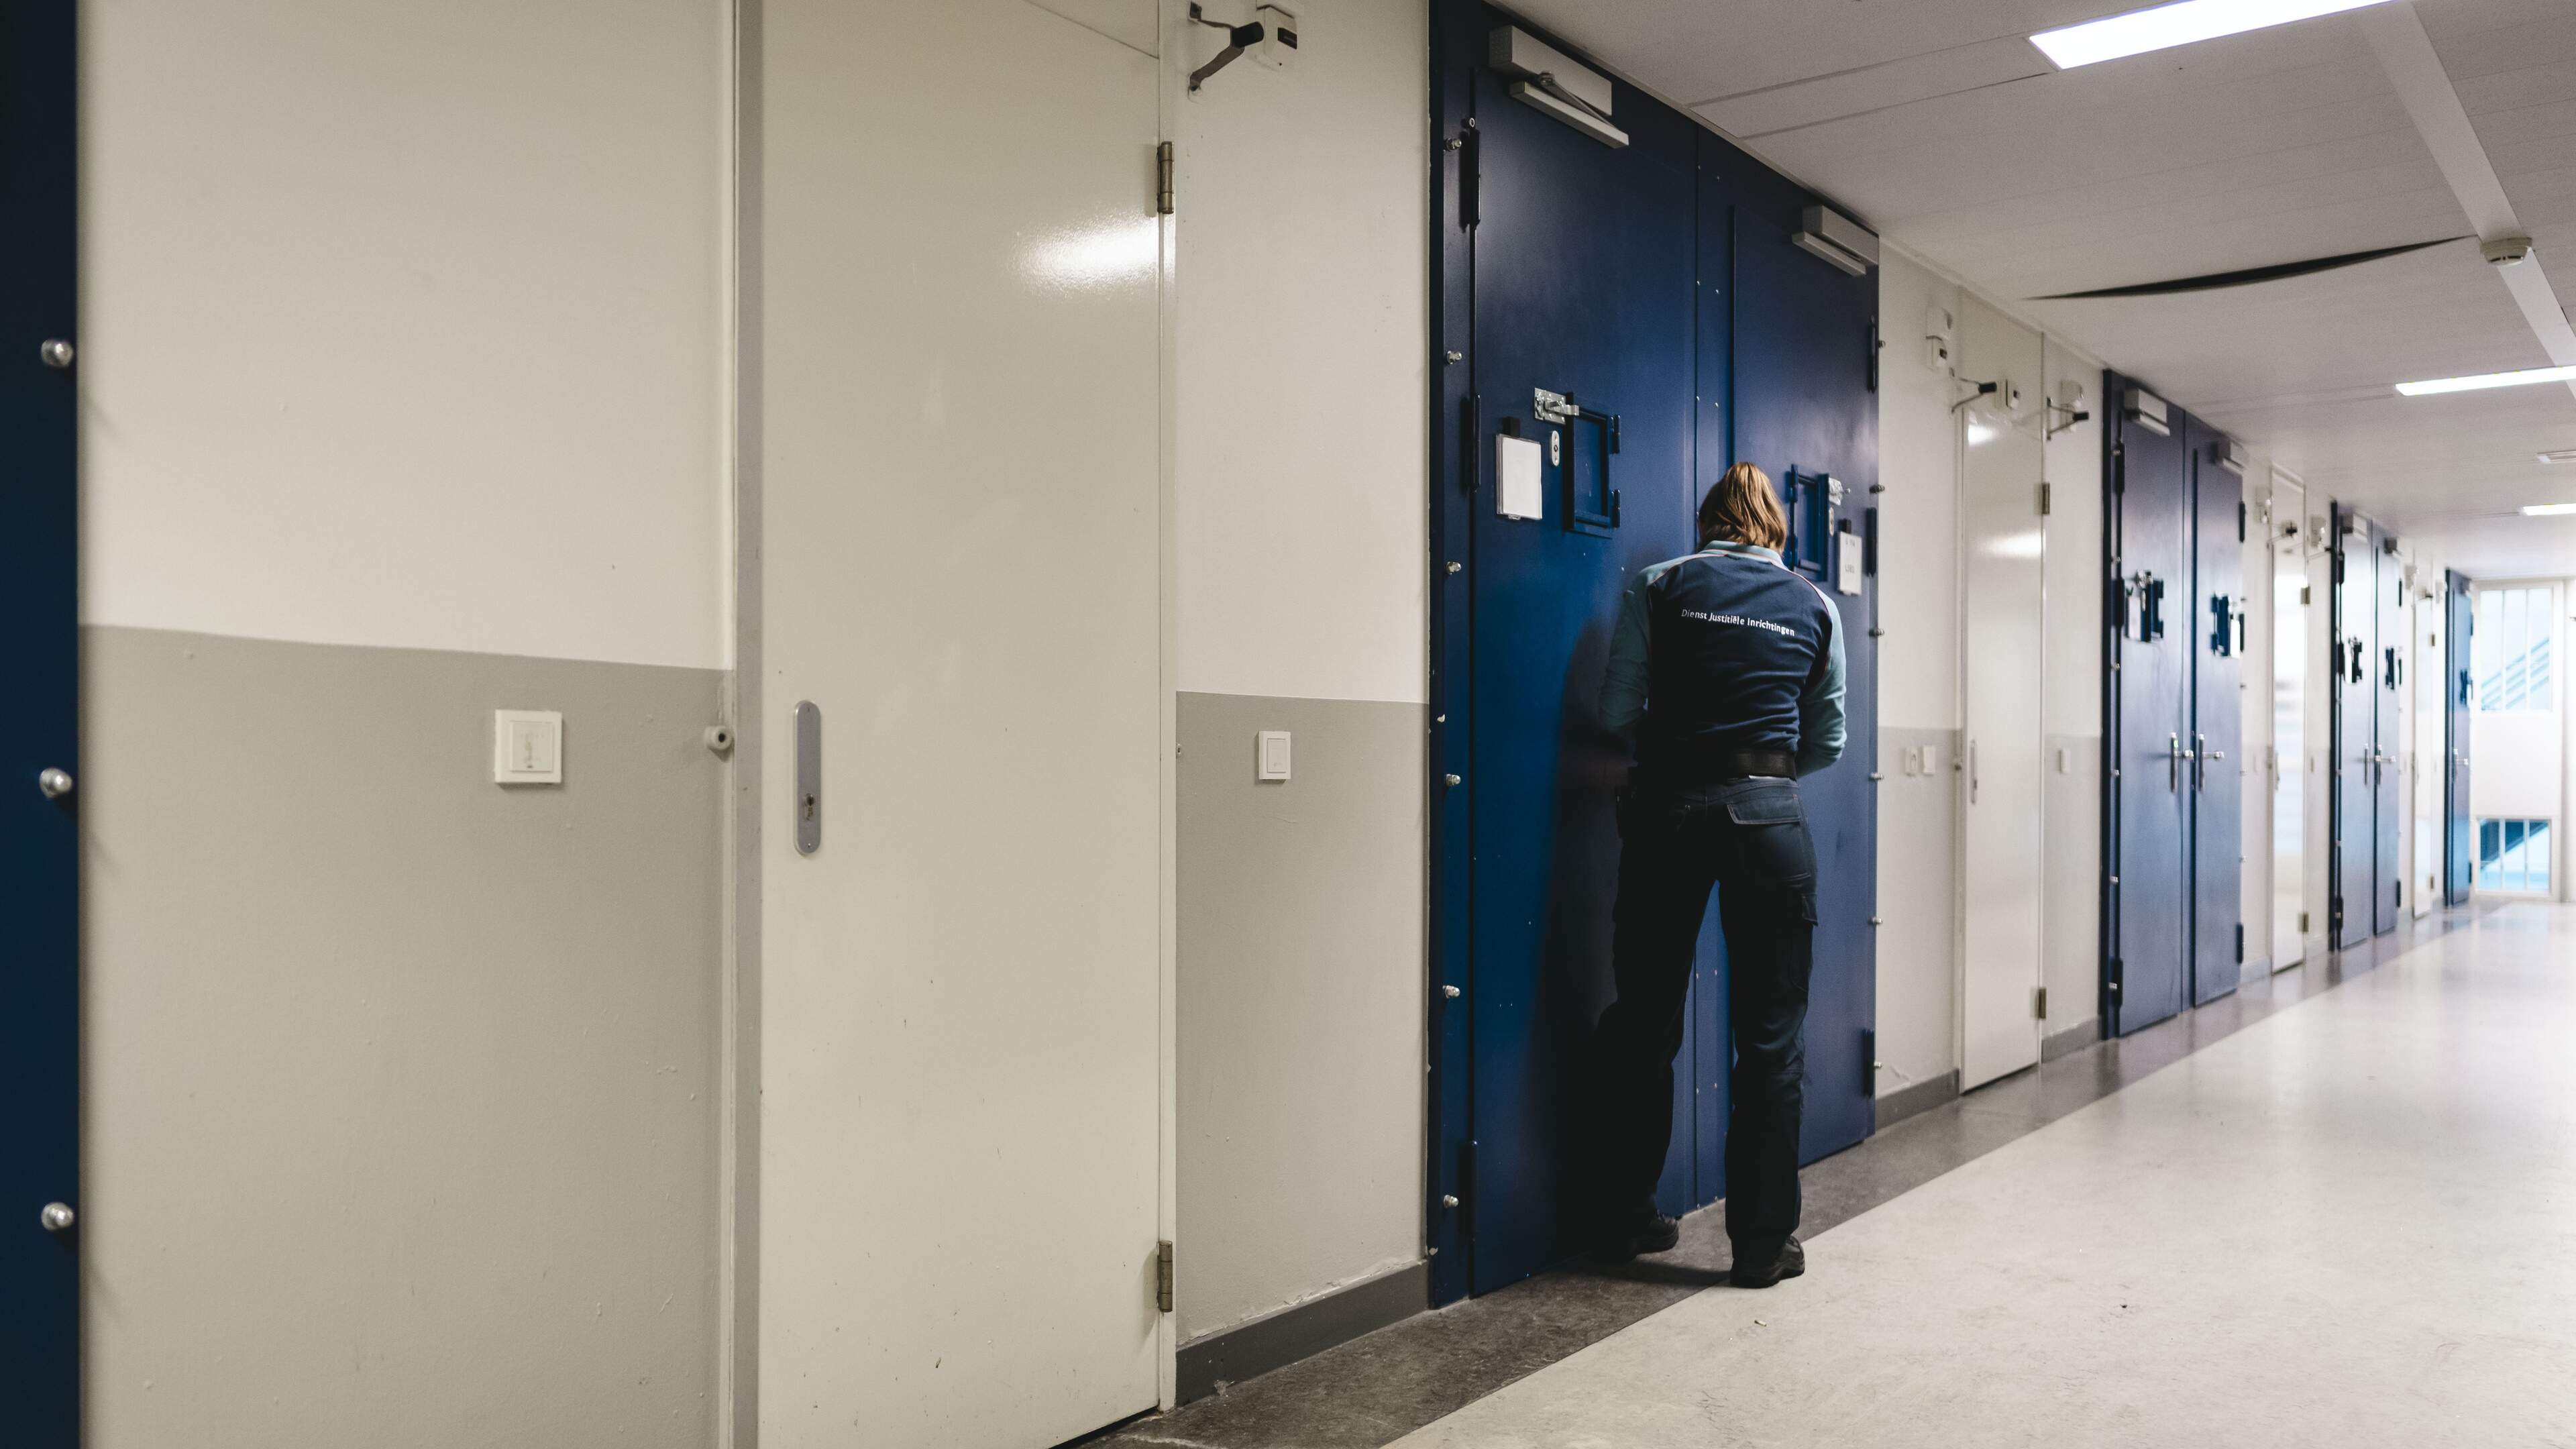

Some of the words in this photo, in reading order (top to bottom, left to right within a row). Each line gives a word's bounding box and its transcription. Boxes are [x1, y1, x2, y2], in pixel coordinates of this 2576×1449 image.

[1681, 609, 1707, 619] Dienst
[1709, 612, 1745, 625] Justitiële
[1747, 617, 1795, 636] Inrichtingen
